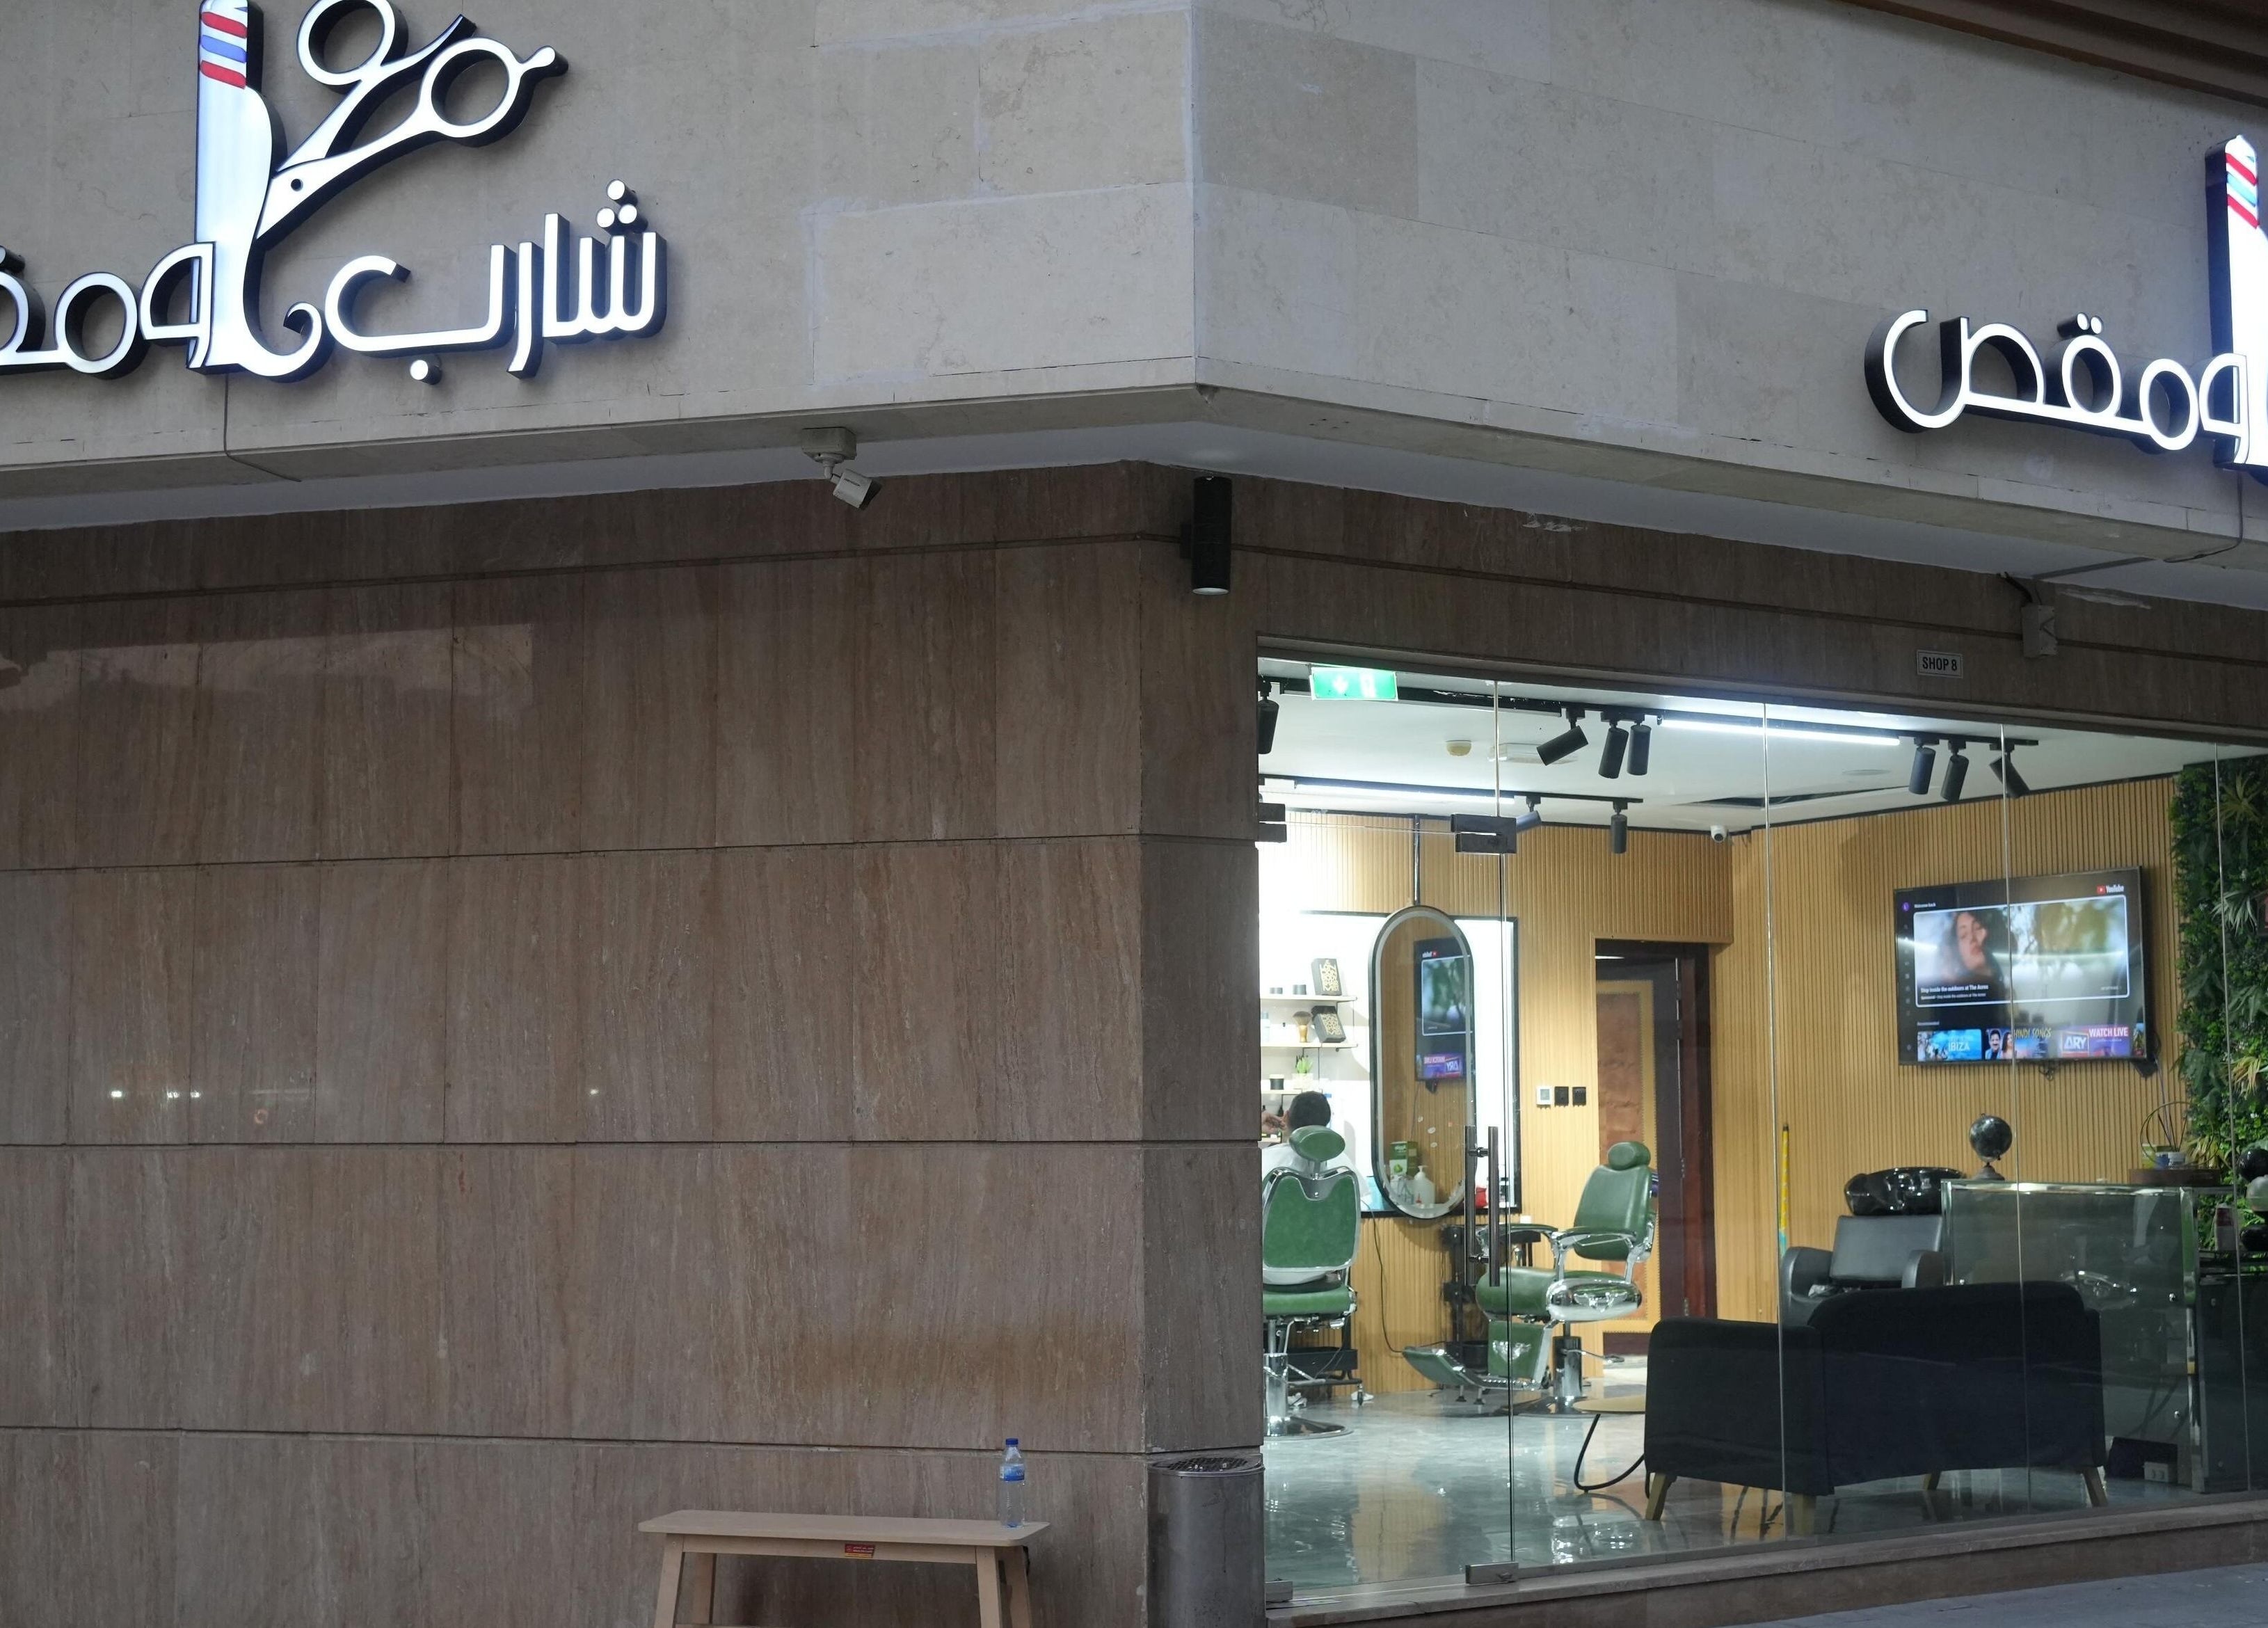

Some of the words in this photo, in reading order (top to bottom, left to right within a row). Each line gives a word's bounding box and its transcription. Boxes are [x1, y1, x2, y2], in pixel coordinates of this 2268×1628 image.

[324, 179, 658, 382] شارب
[1878, 308, 2251, 465] ومقص
[1922, 656, 1949, 671] SHOP
[1951, 659, 1957, 671] 8
[2105, 884, 2125, 893] YouTube
[2032, 1028, 2052, 1039] SONGS
[2089, 1028, 2112, 1038] WATCH
[2114, 1026, 2129, 1037] LIVE
[1949, 1042, 1970, 1051] IBIZA
[2064, 1036, 2086, 1051] ARY
